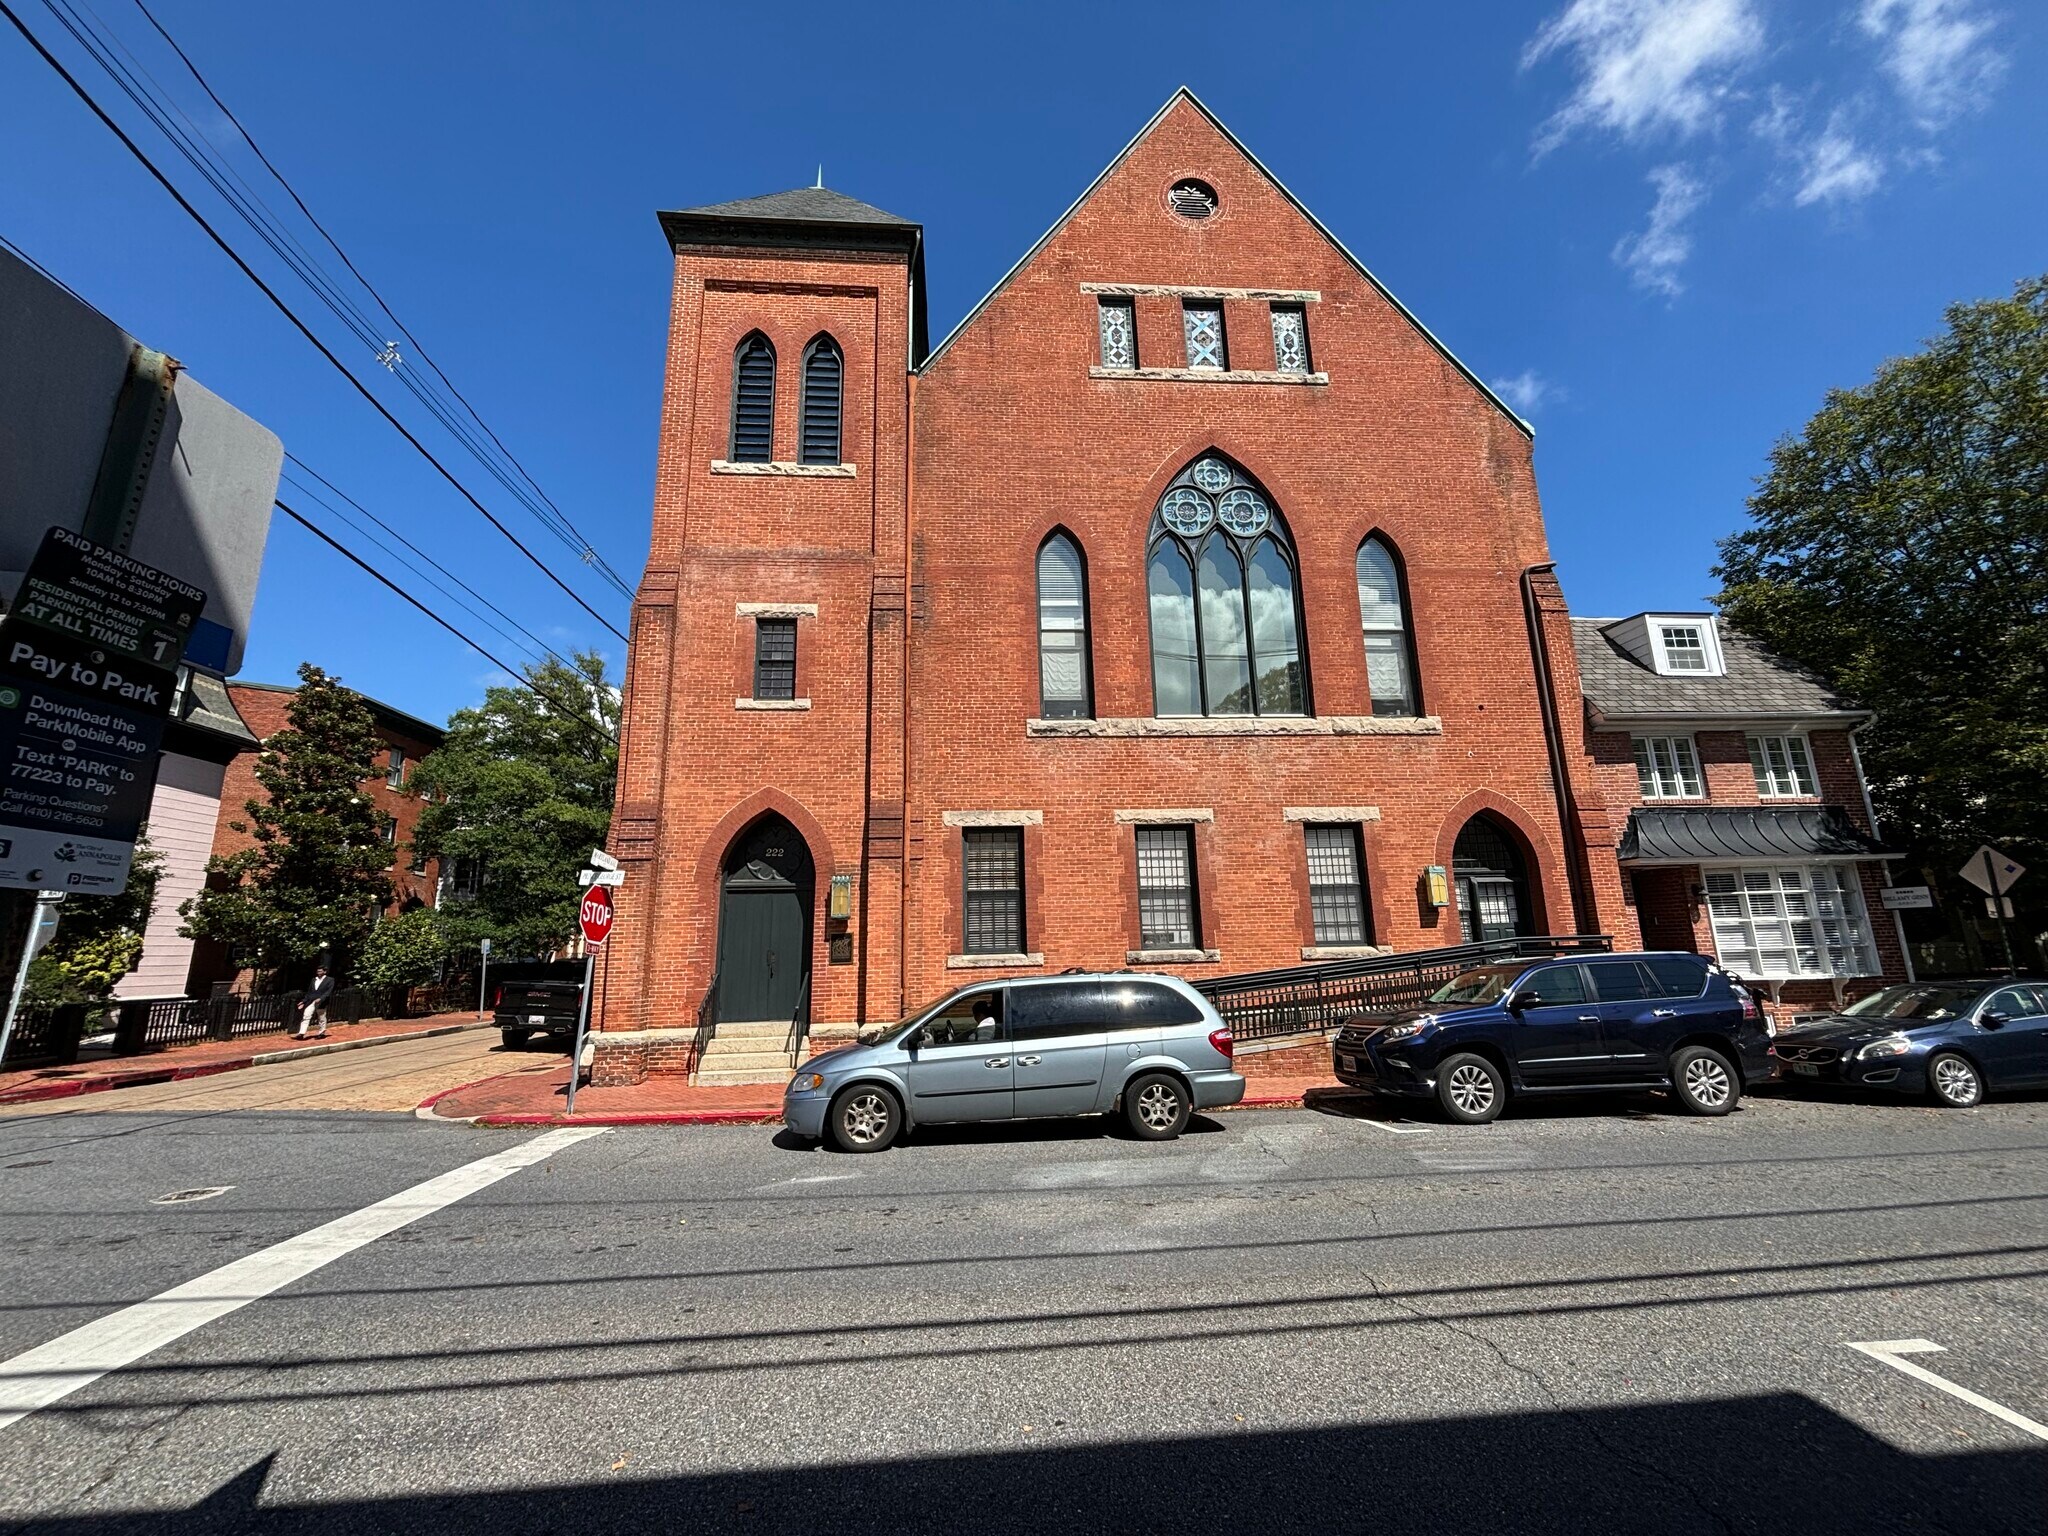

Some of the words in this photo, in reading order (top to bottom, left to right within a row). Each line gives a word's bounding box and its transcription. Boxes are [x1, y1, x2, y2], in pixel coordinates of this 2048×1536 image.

[53, 528, 92, 552] PAID
[93, 547, 157, 581] PARKING
[159, 575, 204, 602] HOURS
[80, 555, 124, 578] Monday
[130, 575, 172, 599] Saturday
[29, 578, 103, 613] RESIDENTIAL
[105, 607, 146, 627] PERMIT
[69, 576, 108, 596] Sunday
[108, 589, 120, 602] 12
[121, 596, 131, 607] to
[132, 601, 166, 620] 7:30PM
[85, 567, 115, 587] 10AM
[116, 579, 127, 590] to
[128, 585, 163, 605] 8:30PM
[20, 603, 50, 620] AT
[50, 613, 84, 634] ALL
[90, 624, 139, 651] TIMES
[29, 592, 84, 616] PARKING
[84, 612, 139, 636] ALLOWED
[152, 630, 178, 644] District
[152, 641, 168, 661] 1
[10, 642, 66, 678] Pay
[71, 662, 98, 686] to
[102, 672, 160, 706] Park
[24, 712, 115, 744] ParkMobile
[116, 739, 146, 754] App
[29, 695, 110, 726] Download
[113, 718, 136, 733] the
[10, 763, 62, 784] 77223
[66, 775, 82, 788] to
[85, 778, 117, 796] Pay.
[16, 745, 55, 765] Text
[120, 769, 135, 781] to
[0, 801, 22, 813] Call
[24, 806, 52, 819] (410)
[54, 812, 103, 827] 216-5620
[3, 788, 47, 805] Parking
[49, 796, 108, 813] Questions?
[766, 848, 784, 856] 222
[583, 901, 611, 926] STOP
